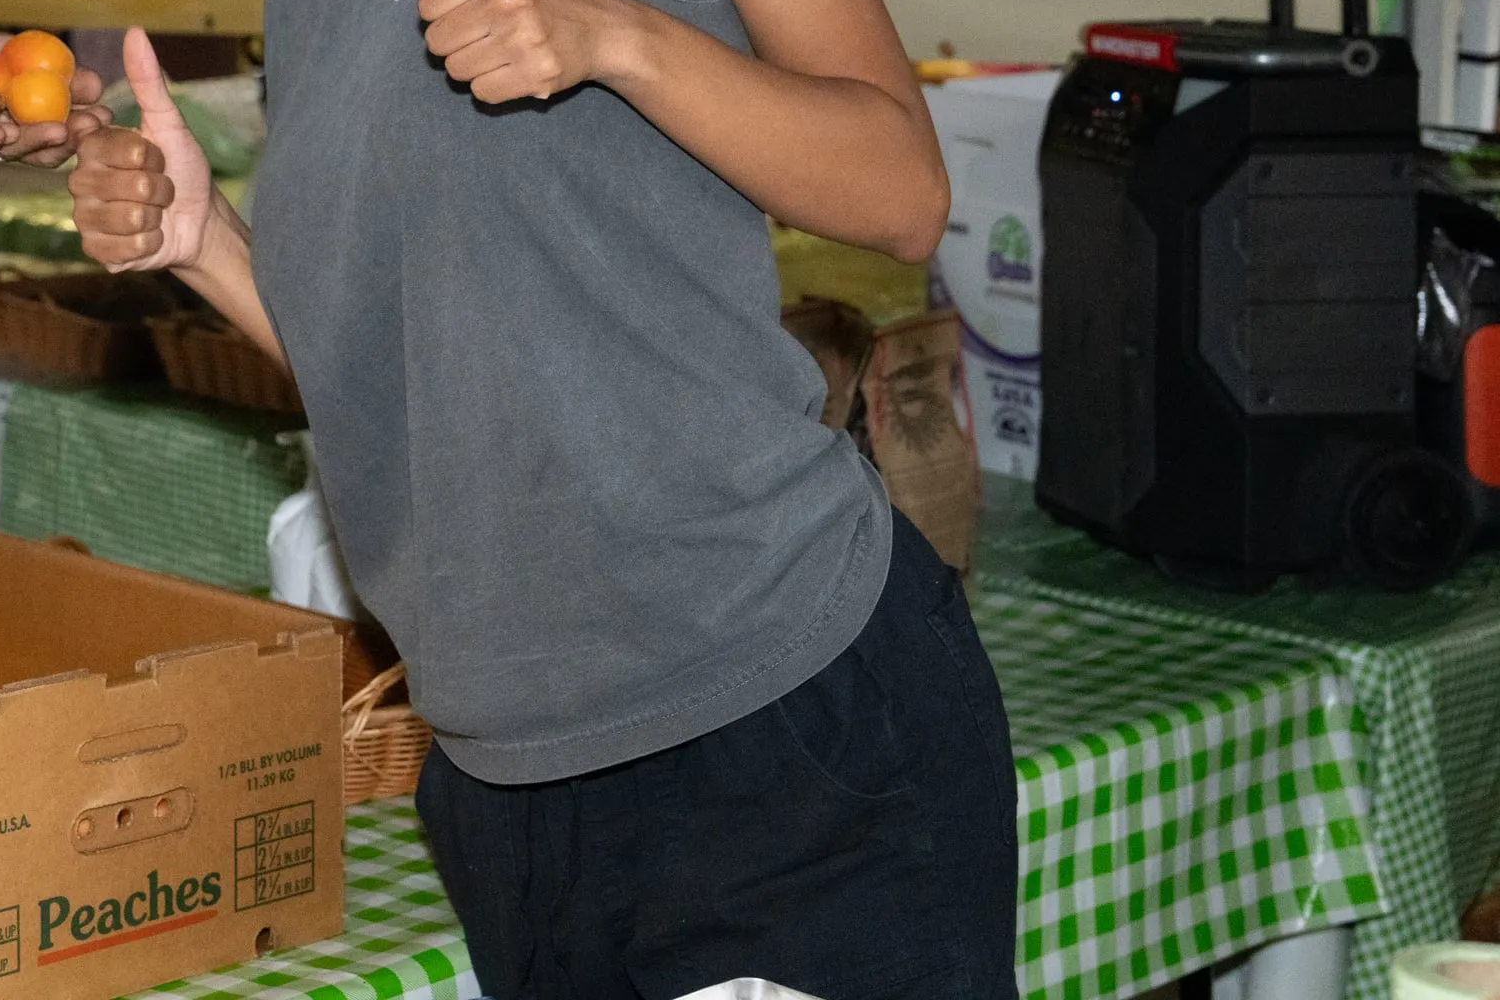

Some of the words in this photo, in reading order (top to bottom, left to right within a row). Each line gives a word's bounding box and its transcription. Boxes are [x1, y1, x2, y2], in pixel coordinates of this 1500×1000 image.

[219, 764, 237, 779] 1/2
[260, 755, 274, 769] BY
[276, 743, 322, 764] VOLUME
[247, 774, 276, 792] 11.39
[279, 768, 295, 783] KG
[38, 869, 222, 951] Peaches
